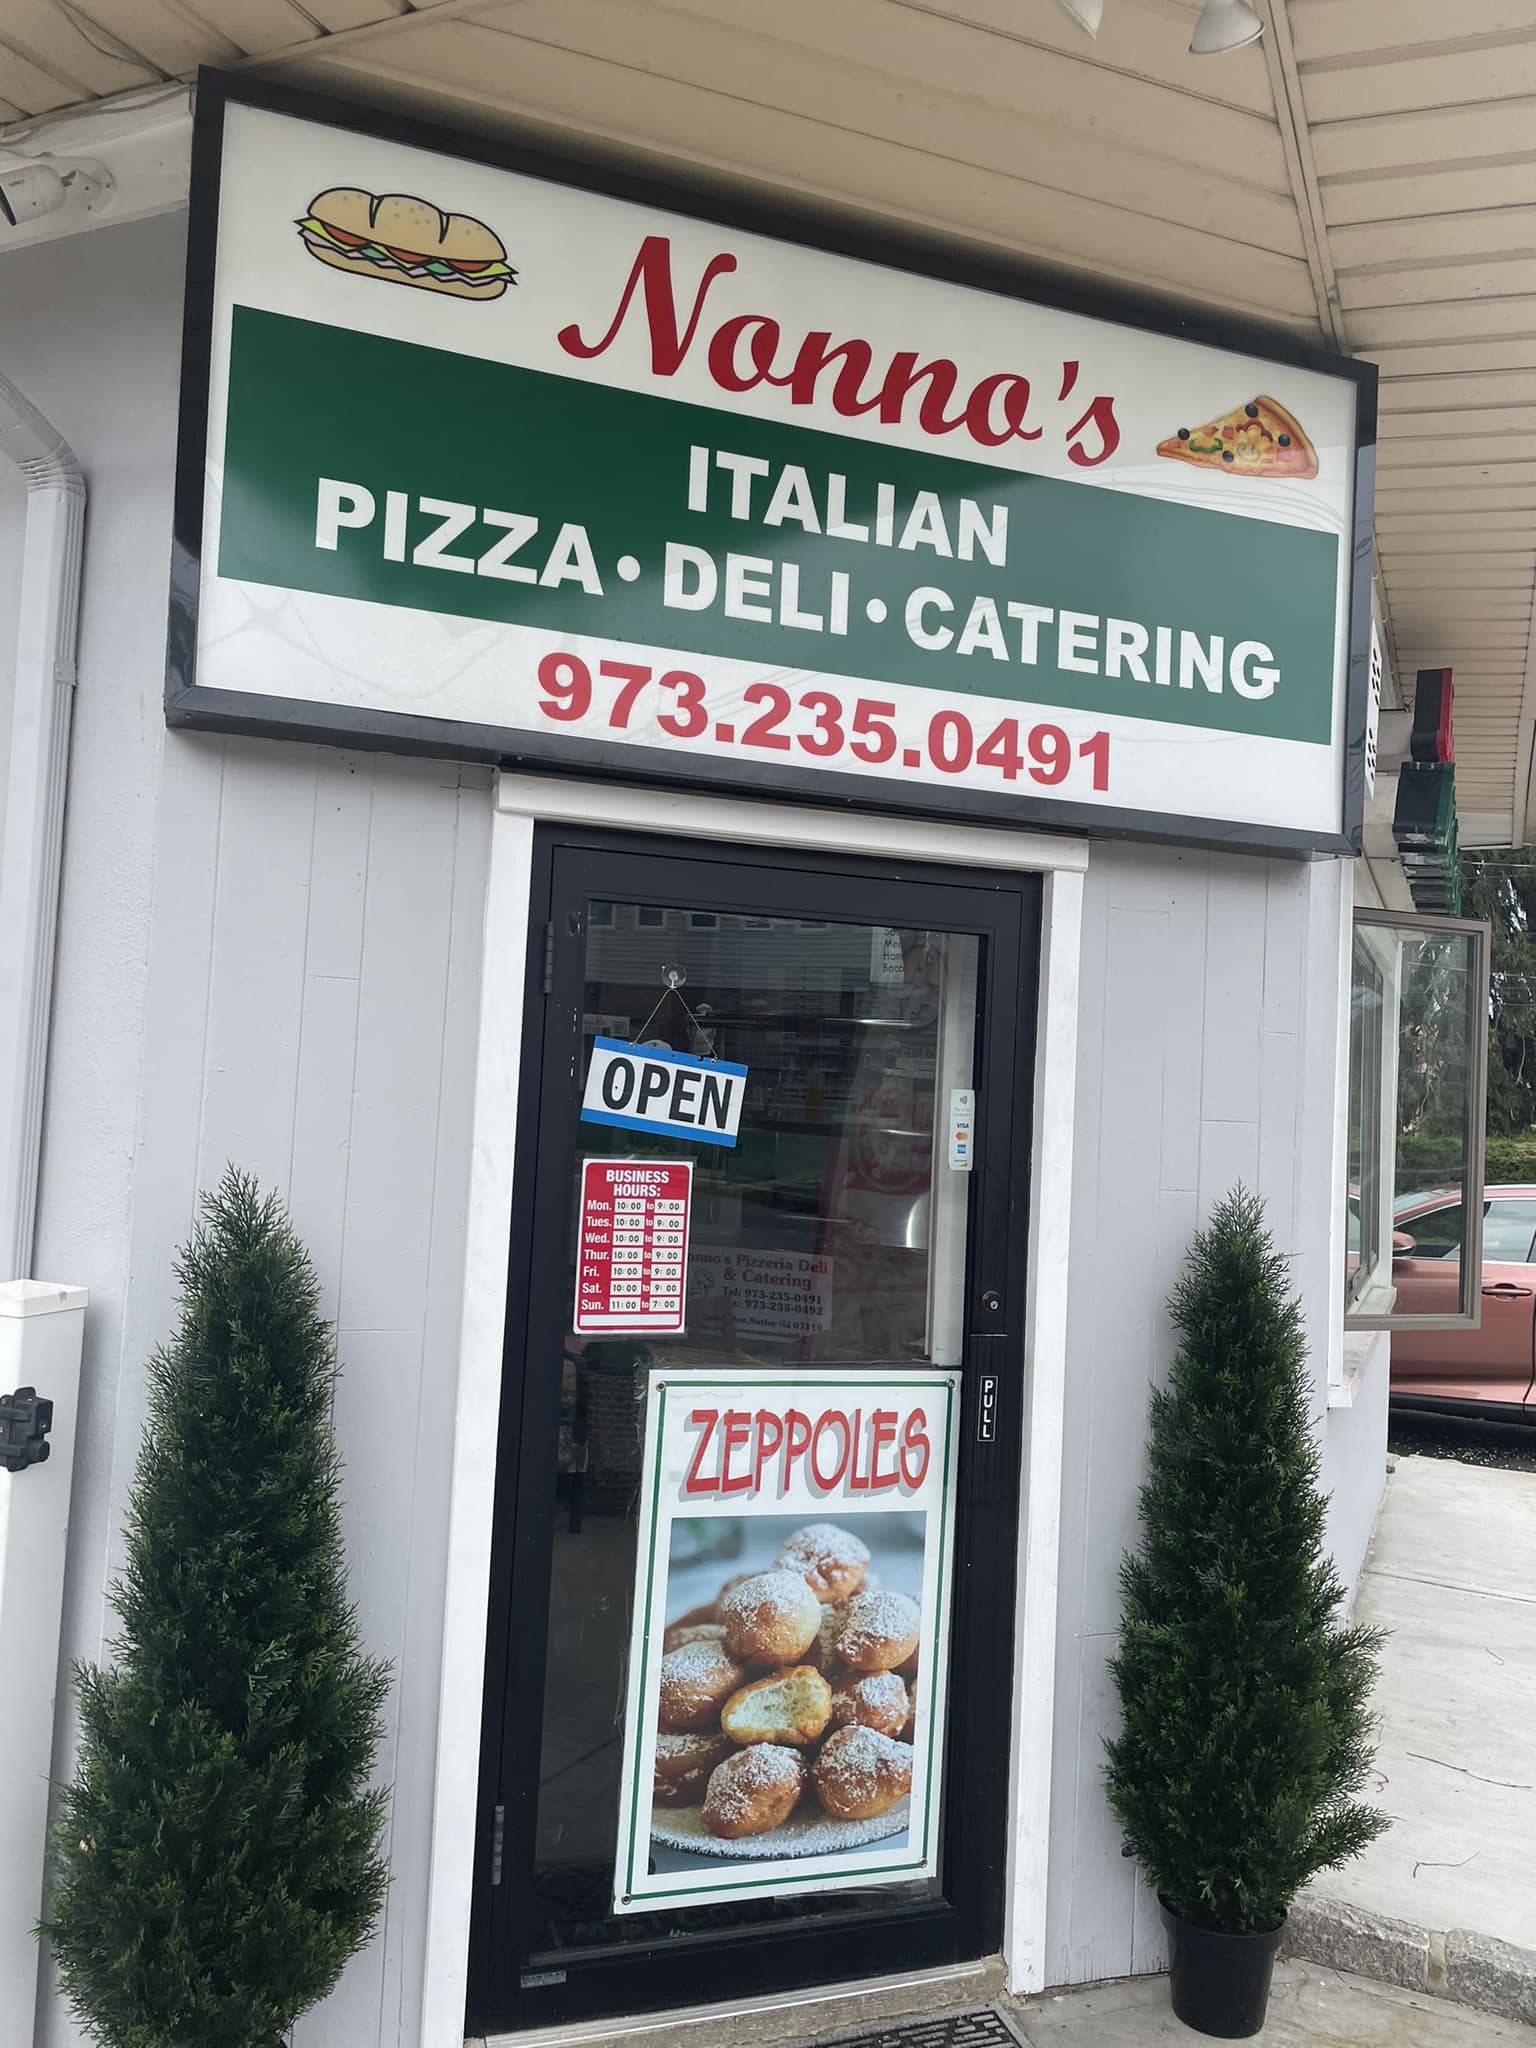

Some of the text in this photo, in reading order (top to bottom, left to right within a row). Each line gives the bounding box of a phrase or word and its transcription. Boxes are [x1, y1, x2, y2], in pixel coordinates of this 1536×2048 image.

[557, 236, 1120, 467] Nonno's
[688, 445, 1009, 567] ITALIAN
[315, 477, 1281, 700] PIZZA DELI CATERING
[537, 652, 1110, 792] 973.235.0491
[602, 1057, 734, 1130] OPEN
[606, 1169, 670, 1184] BUSINESS
[613, 1184, 661, 1197] HOURS:
[587, 1200, 612, 1211] Mon.
[646, 1201, 654, 1210] to
[586, 1216, 612, 1227] Tues.
[645, 1218, 654, 1226] to
[585, 1233, 610, 1243] Wed.
[645, 1235, 653, 1243] to
[584, 1249, 610, 1260] Thur.
[643, 1251, 651, 1259] to
[583, 1266, 600, 1277] Fri.
[643, 1267, 651, 1276] to
[688, 1253, 828, 1274] onno's Pizzeria Deli
[723, 1267, 812, 1291] & Catering
[582, 1283, 602, 1294] Sat.
[642, 1284, 650, 1292] to
[581, 1299, 604, 1310] Sun.
[641, 1301, 649, 1309] to
[744, 1289, 822, 1305] 973-235-0491
[745, 1300, 823, 1316] 973-235-0492
[983, 1379, 995, 1439] PULL
[684, 1408, 931, 1496] ZEPPOLES
